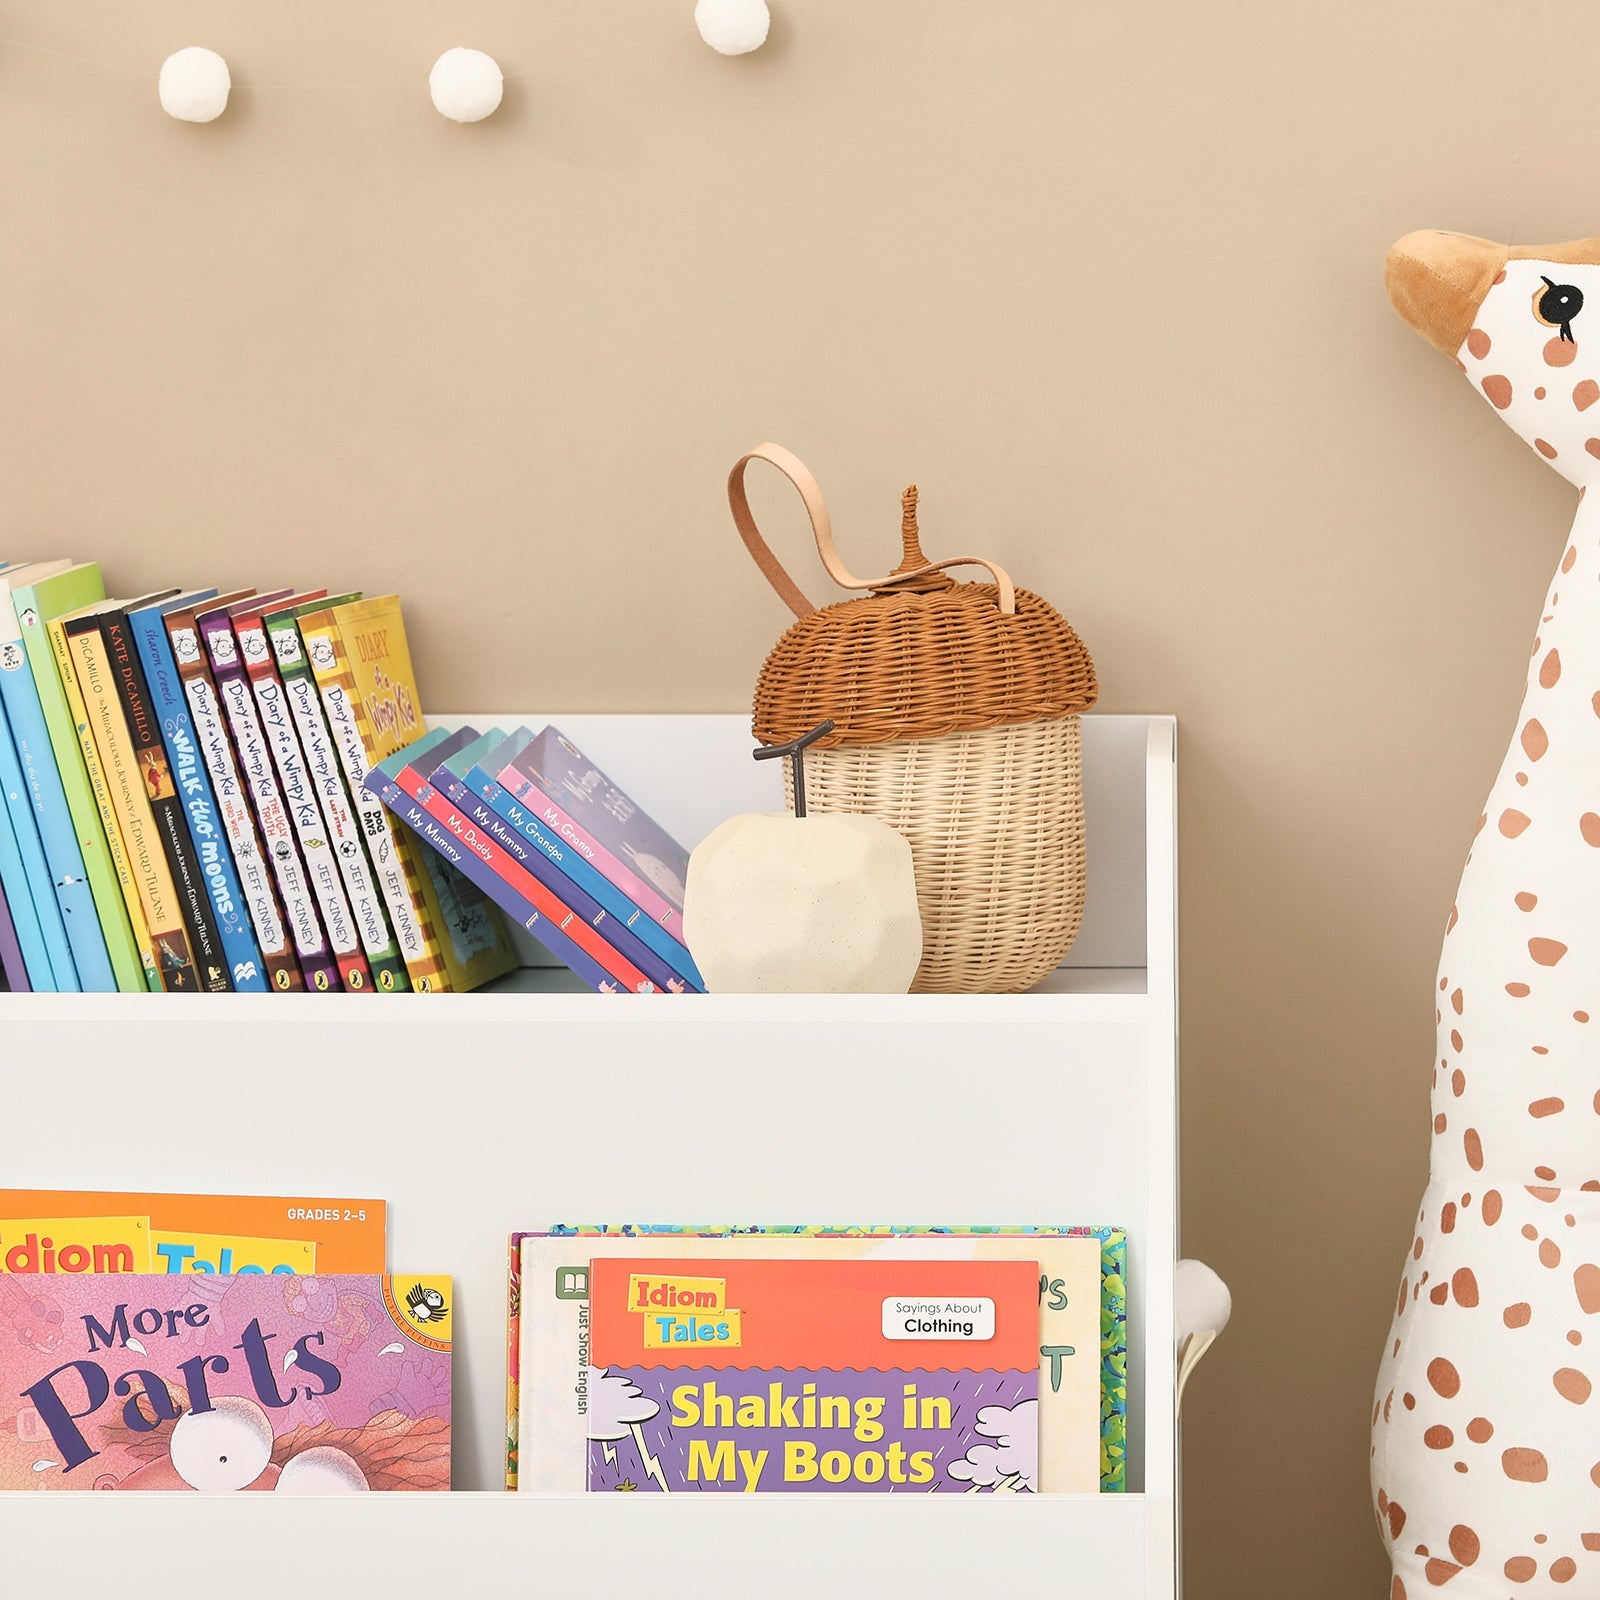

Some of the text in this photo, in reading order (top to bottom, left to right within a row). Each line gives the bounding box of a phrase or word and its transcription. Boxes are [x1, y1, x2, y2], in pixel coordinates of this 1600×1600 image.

[54, 631, 72, 684] SHARMAT SIMONT
[109, 625, 128, 664] KATE
[355, 631, 389, 662] DIARY
[145, 629, 176, 706] Sharon Creech
[192, 682, 211, 715] Diary
[229, 683, 249, 717] Diary
[259, 685, 285, 727] Diary
[293, 682, 313, 716] Diary
[328, 688, 348, 723] Diary
[207, 719, 215, 729] of
[244, 721, 253, 730] of
[279, 732, 290, 742] of
[309, 720, 317, 729] of
[344, 726, 352, 735] of
[210, 738, 226, 775] Wimpy
[247, 739, 263, 776] Wimpy
[312, 738, 328, 775] Wimpy
[347, 744, 364, 781] Wimpy
[220, 777, 235, 795] Kid
[258, 778, 272, 796] Kid
[283, 754, 305, 801] Wimpy
[323, 777, 337, 796] Kid
[84, 740, 129, 886] NATE THE GREAT AND THE STICKY CASE
[172, 729, 234, 914] WALK two moons
[224, 800, 241, 839] THIRD WHEEL
[262, 807, 275, 837] TRUTH
[269, 798, 288, 838] THE UGLY
[296, 803, 316, 826] Kid
[329, 800, 344, 838] LAST STRAW
[339, 809, 347, 822] THE
[364, 811, 376, 836] DAYS
[372, 810, 385, 833] DOG
[407, 808, 461, 862] My Mummy
[447, 814, 493, 860] My Daddy
[474, 806, 528, 859] My Mummy
[508, 807, 563, 861] My Grandpa
[544, 808, 595, 858] My Granny
[130, 819, 152, 873] EDWARD
[146, 873, 168, 924] TULANE
[246, 863, 278, 946] JEFF KINNEY
[284, 865, 315, 946] JEFF KINNEY
[318, 864, 349, 945] JEFF KINNEY
[350, 864, 381, 946] JEFF KINNEY
[386, 870, 418, 951] JEFF KINNEY
[287, 1208, 340, 1220] GRADES
[0, 1232, 134, 1273] diom
[636, 1281, 717, 1308] Idiom
[896, 1302, 982, 1315] Sayings About
[80, 1303, 210, 1353] More
[384, 1288, 446, 1349] PICTURE PUFFINS
[655, 1316, 730, 1343] Tales
[904, 1319, 974, 1335] Clothing
[575, 1304, 589, 1415] Just Show English
[20, 1318, 342, 1473] Parts
[671, 1381, 952, 1442] Shaking in
[687, 1440, 936, 1492] My Boots
